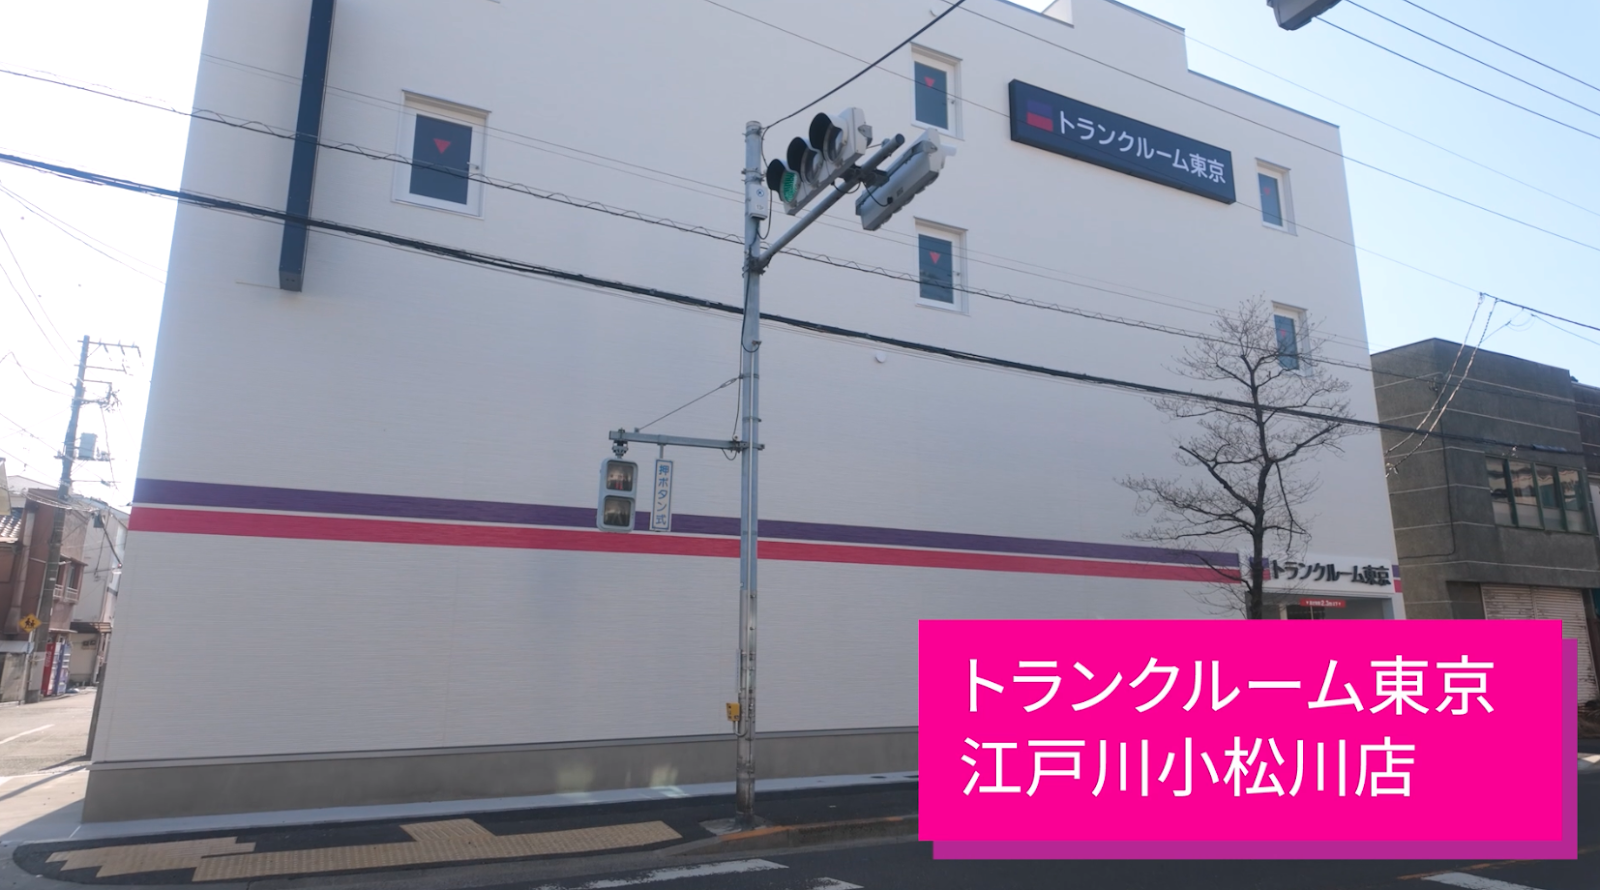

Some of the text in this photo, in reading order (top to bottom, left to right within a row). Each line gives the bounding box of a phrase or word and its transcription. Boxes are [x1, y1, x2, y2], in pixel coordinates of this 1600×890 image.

[1059, 110, 1226, 184] トランクルーム東京
[655, 464, 669, 526] 押ボタン式
[1272, 559, 1391, 586] トランクルーム東京
